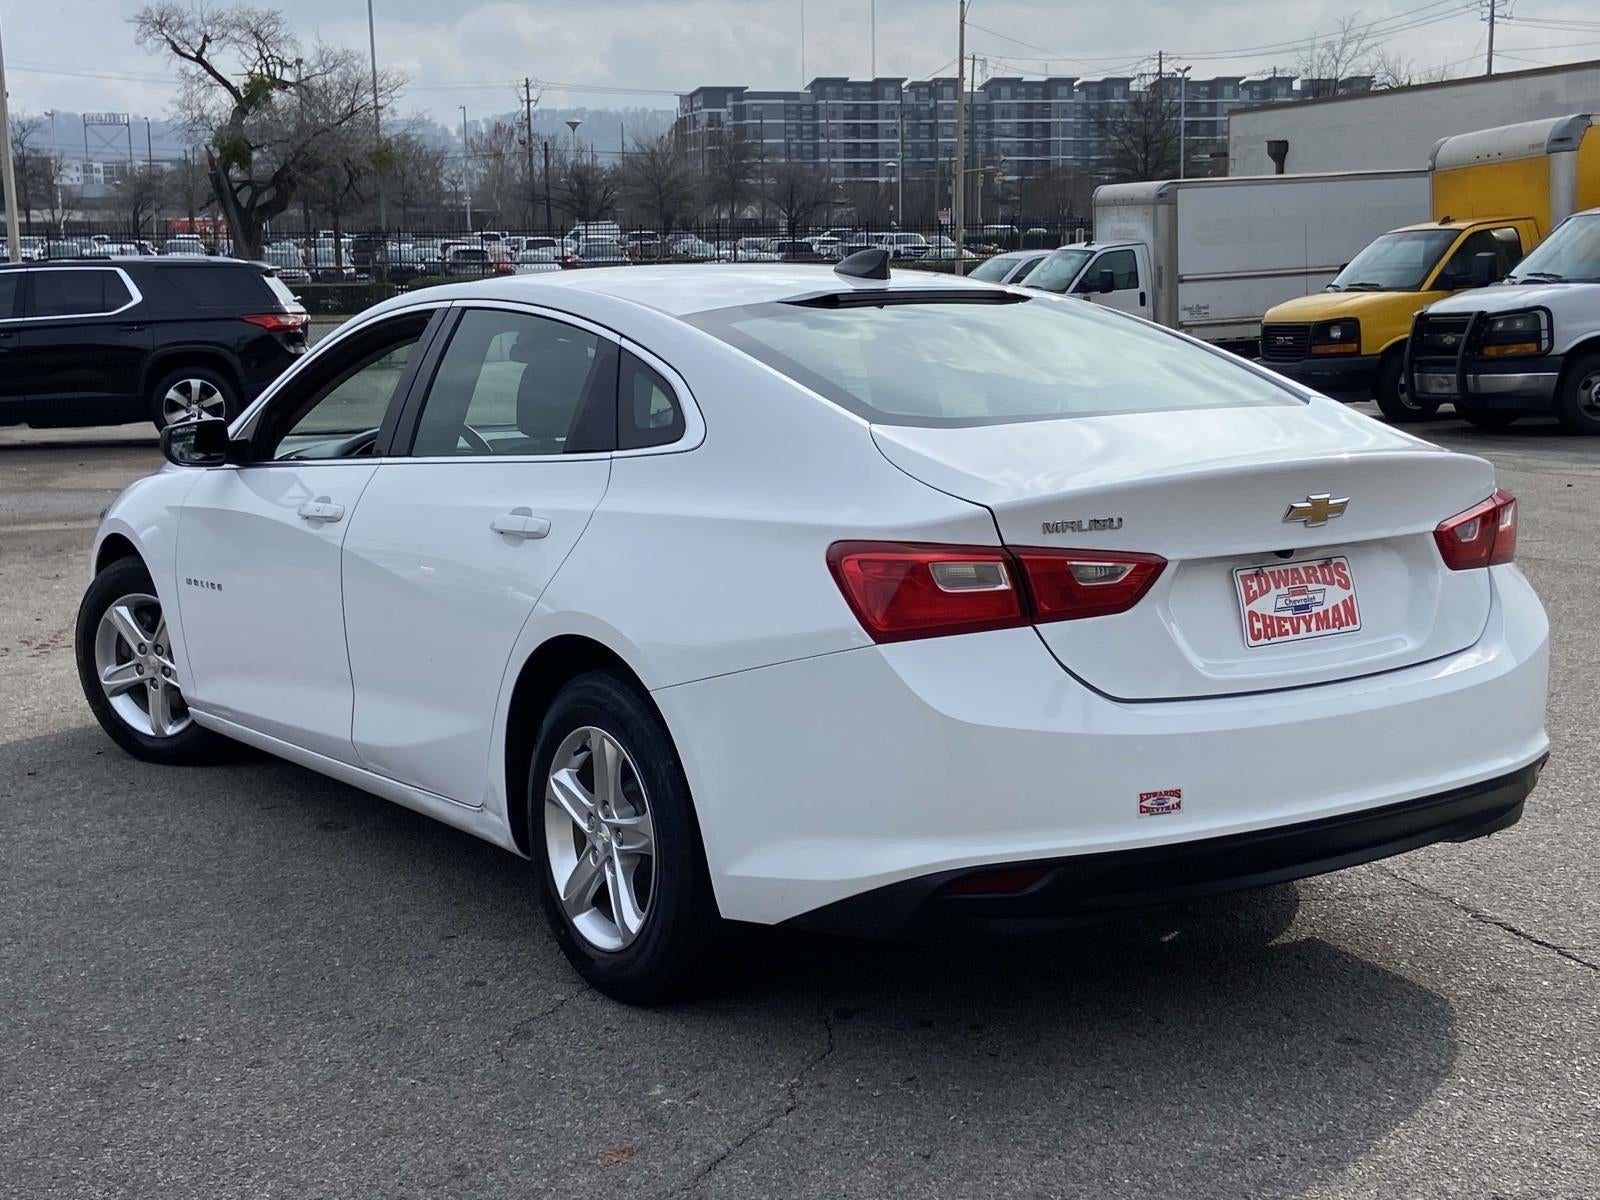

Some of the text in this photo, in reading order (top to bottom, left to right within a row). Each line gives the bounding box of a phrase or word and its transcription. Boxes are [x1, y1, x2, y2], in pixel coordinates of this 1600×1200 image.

[1042, 517, 1123, 535] MALIBU
[1240, 561, 1351, 607] EDWARDS
[1284, 595, 1316, 606] Chevrolet
[1247, 594, 1358, 641] CHEVYMAN
